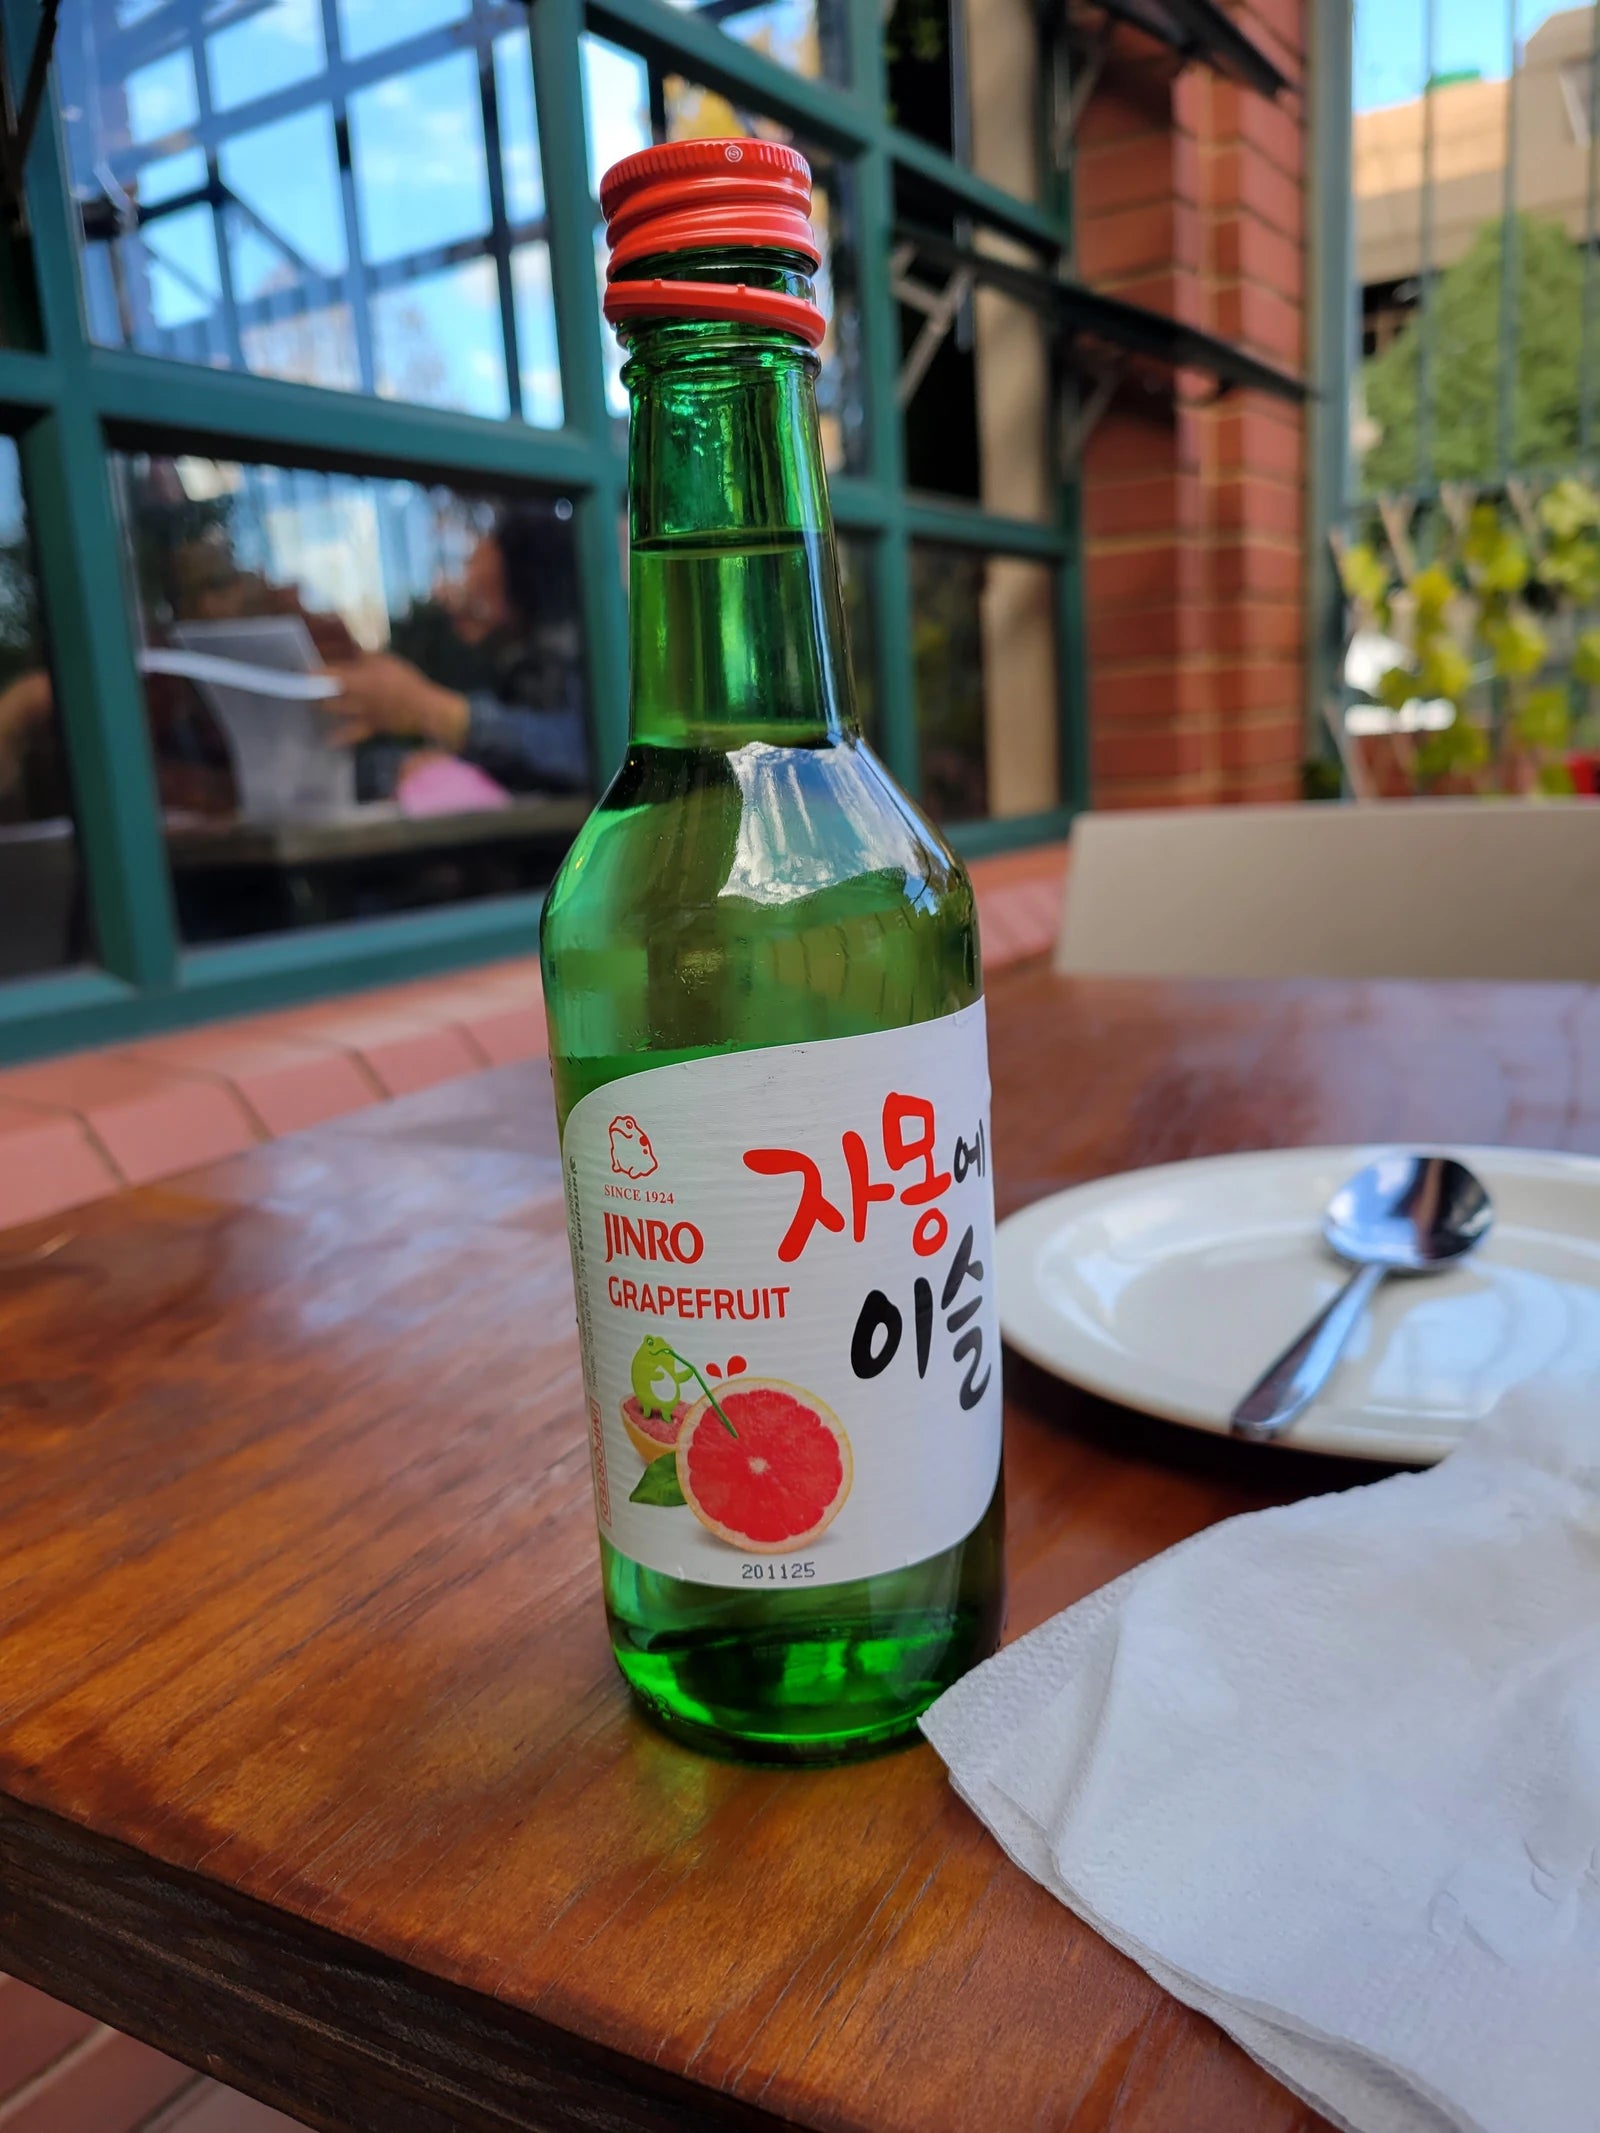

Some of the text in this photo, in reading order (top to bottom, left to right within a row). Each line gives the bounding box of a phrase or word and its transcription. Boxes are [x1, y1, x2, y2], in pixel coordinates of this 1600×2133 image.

[604, 1184, 674, 1204] SINCE 1924
[743, 1092, 985, 1262] 자몽에
[604, 1212, 704, 1264] JINRO
[608, 1275, 790, 1320] GRAPEFRUIT
[851, 1225, 991, 1410] 이슬
[591, 1405, 609, 1516] IMPORTED
[741, 1561, 816, 1579] 201125
